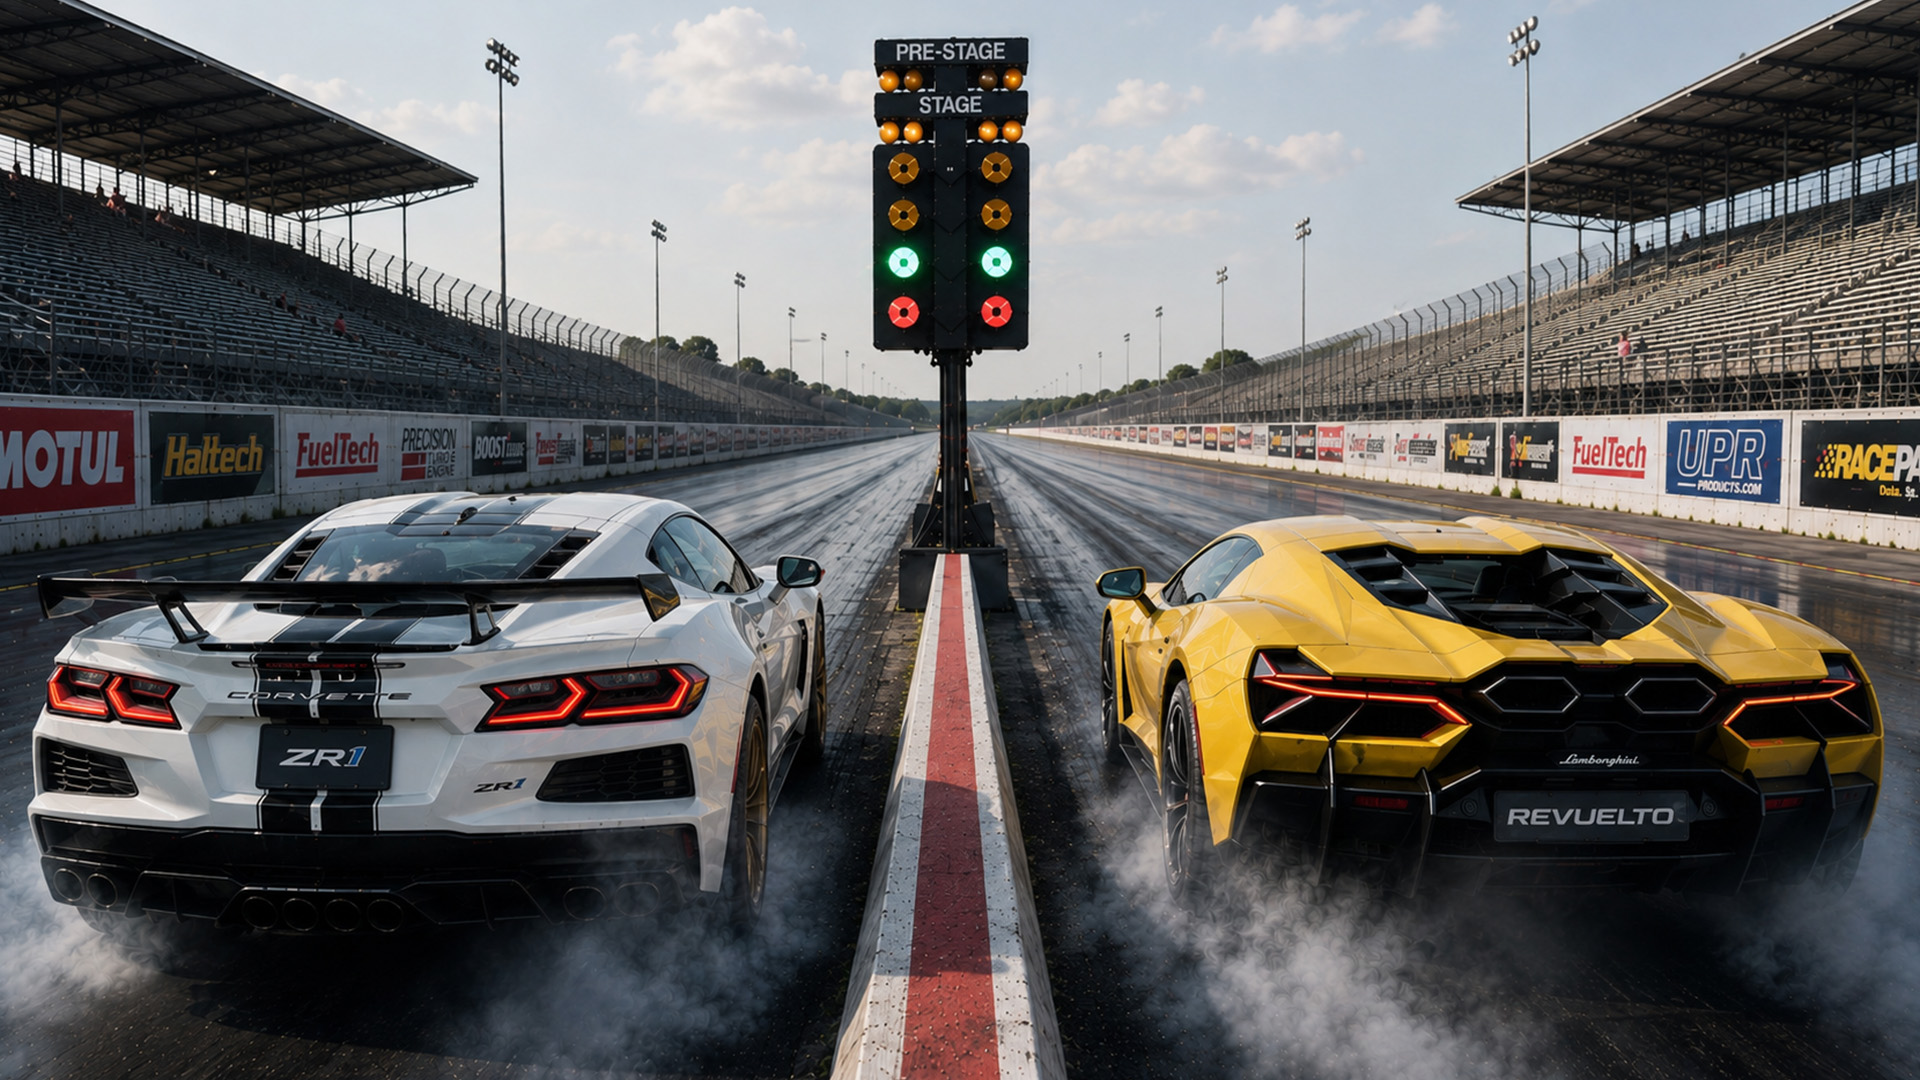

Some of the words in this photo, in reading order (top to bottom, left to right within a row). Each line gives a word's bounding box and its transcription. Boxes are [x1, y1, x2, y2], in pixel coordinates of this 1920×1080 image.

[896, 42, 1006, 61] PRE-STAGE
[919, 95, 982, 114] STAGE
[296, 432, 379, 467] FuelTech
[401, 427, 457, 451] PRECISION
[474, 435, 508, 460] BOOST
[0, 429, 124, 490] MOTUL
[163, 433, 264, 478] Haltech
[1573, 436, 1647, 469] FuelTech
[1676, 429, 1766, 480] UPR
[227, 691, 412, 701] CORVETTE
[278, 746, 367, 767] ZR1
[473, 778, 527, 794] ZR1
[1507, 808, 1675, 825] REVUELTO
